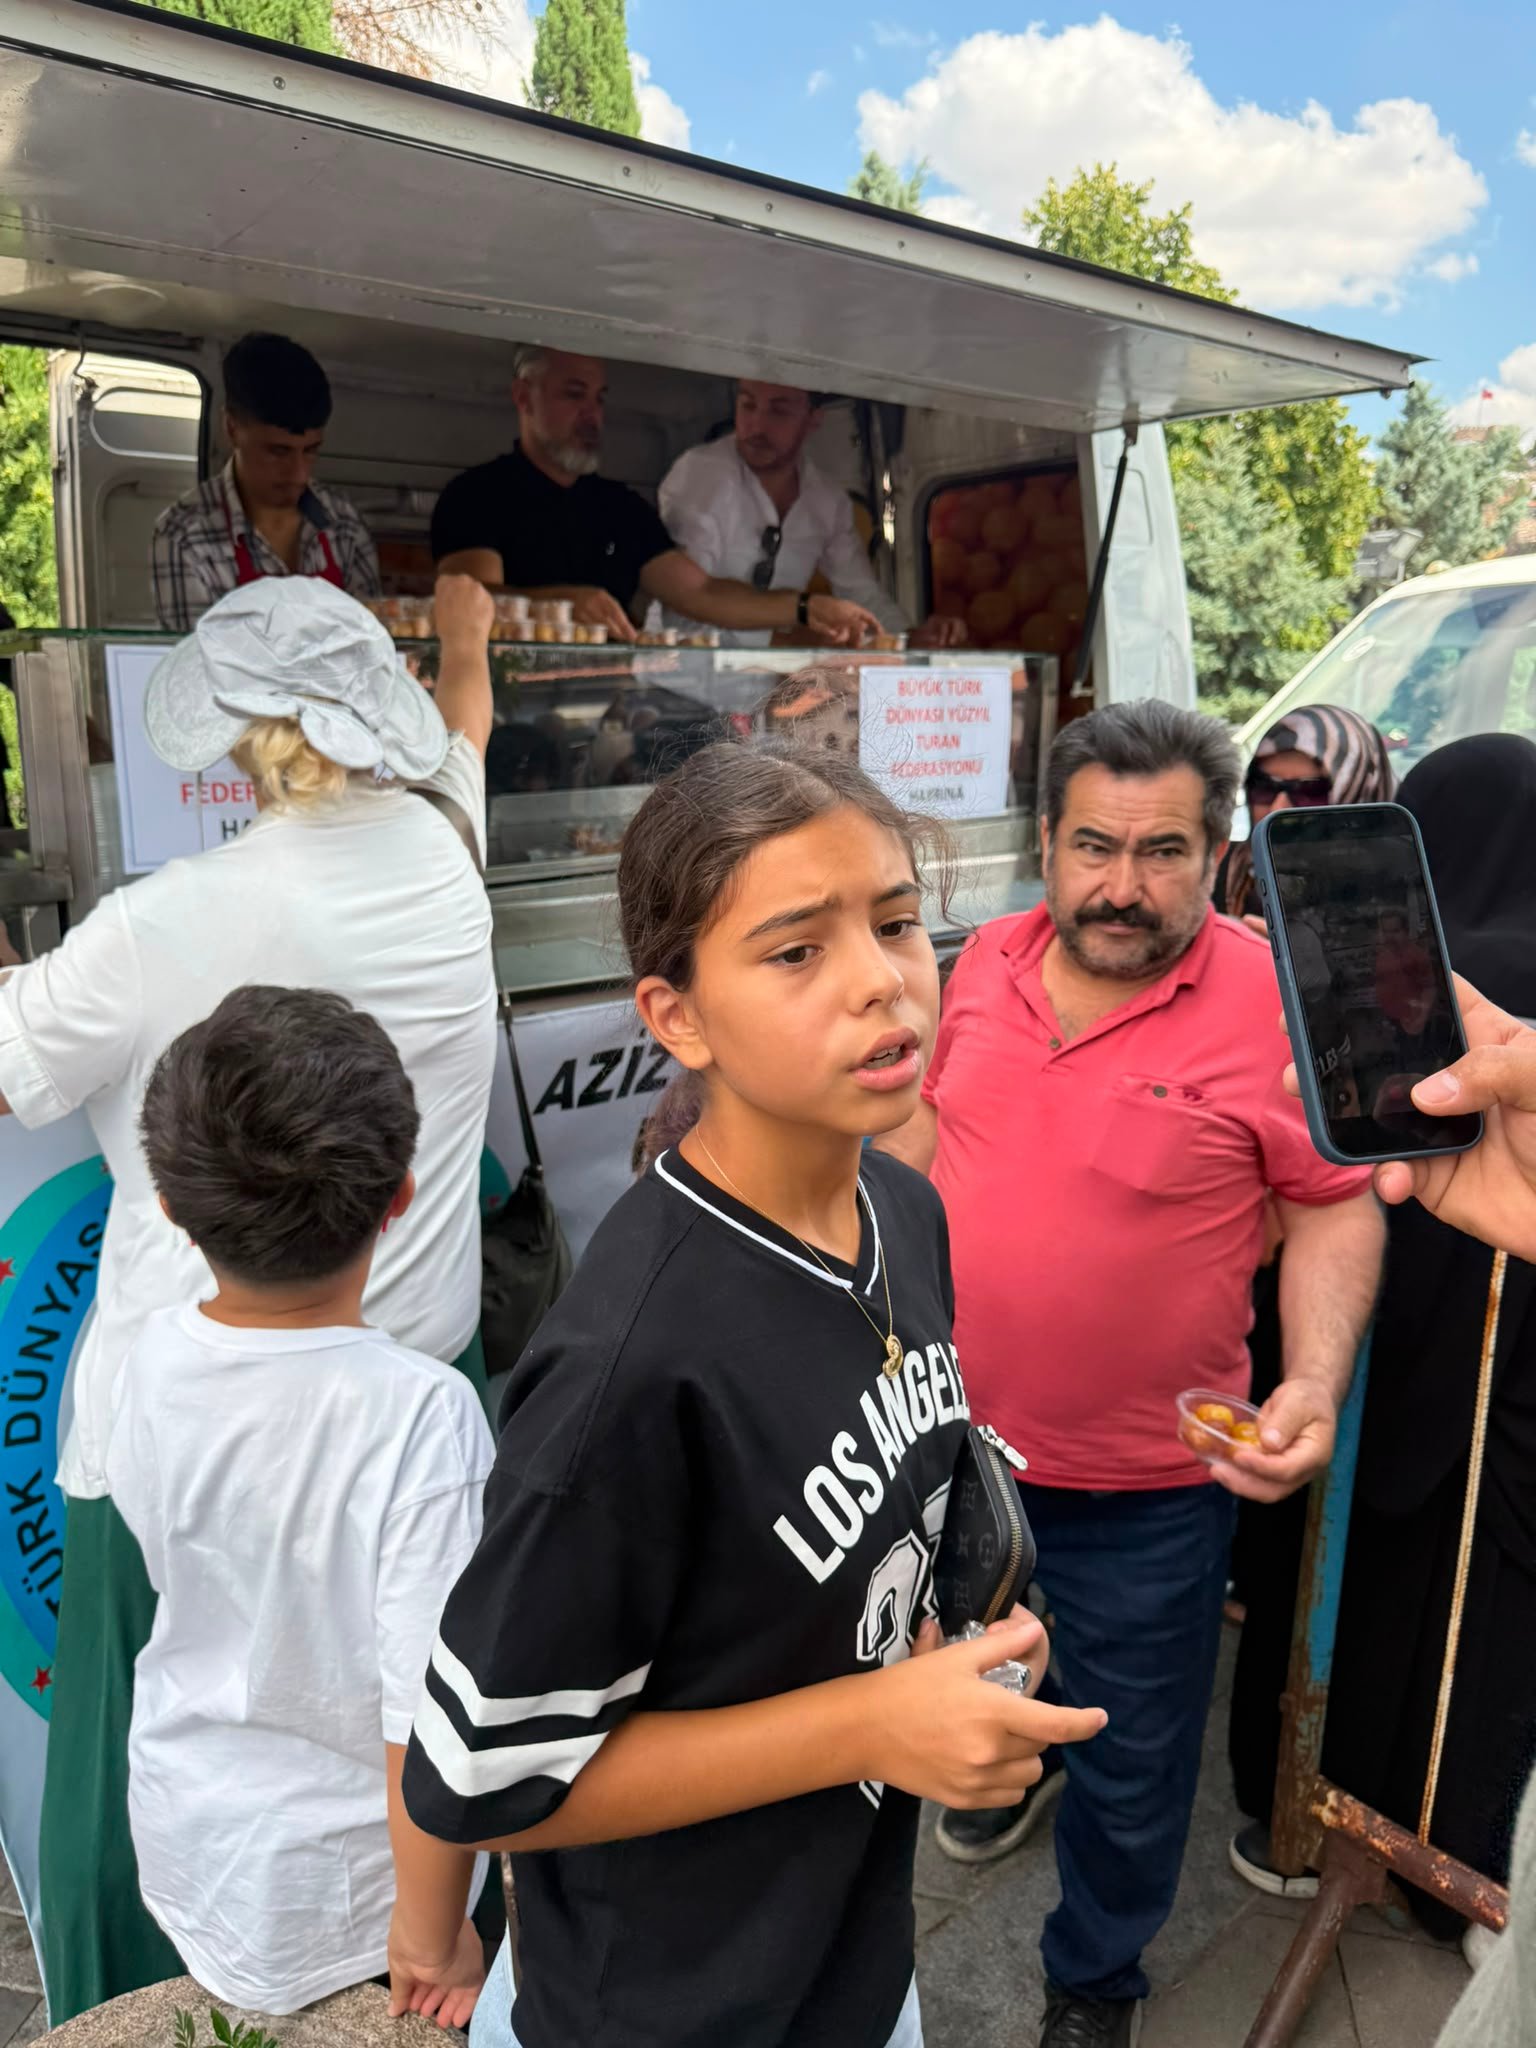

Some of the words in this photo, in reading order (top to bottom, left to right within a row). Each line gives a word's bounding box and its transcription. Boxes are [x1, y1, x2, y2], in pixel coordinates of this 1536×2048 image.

[897, 677, 943, 696] BÜYÜK
[947, 676, 982, 696] TÜRK
[886, 704, 943, 724] DÜNYASI
[916, 733, 961, 750] TURAN
[1, 1206, 110, 1448] DÜNYAS
[772, 1430, 885, 1585] LOS
